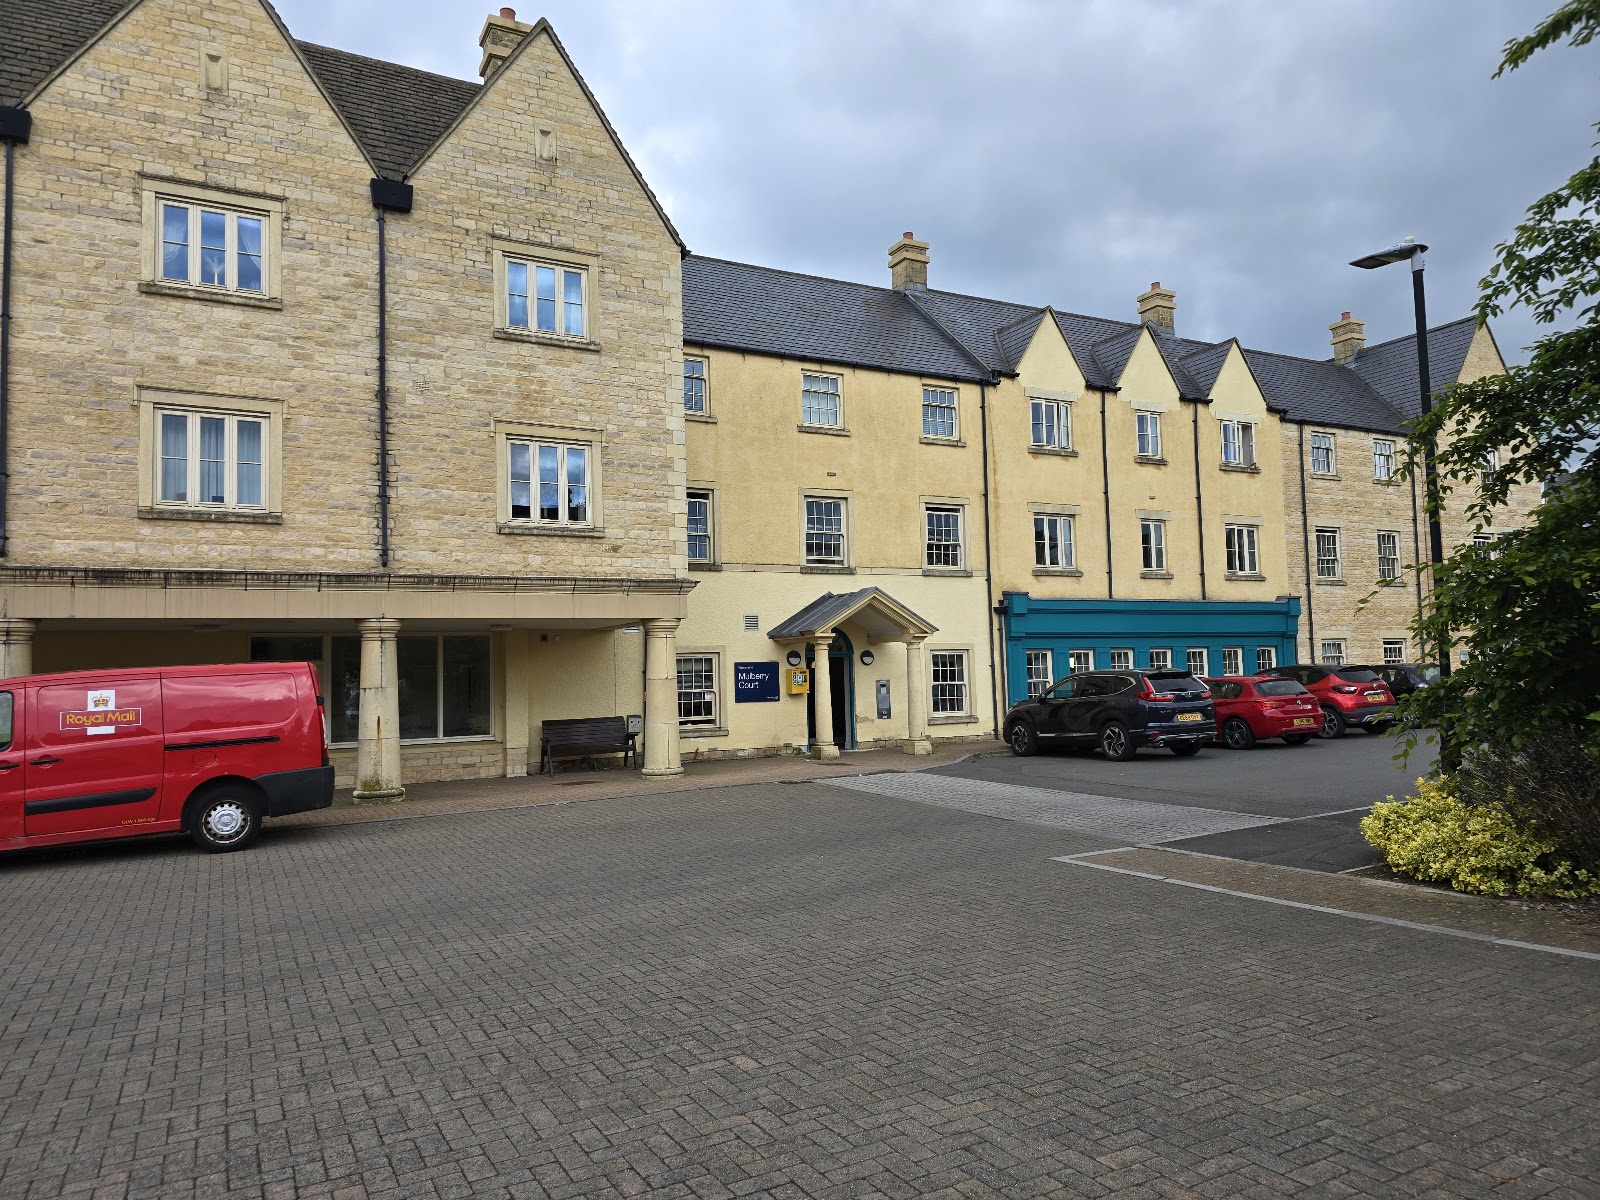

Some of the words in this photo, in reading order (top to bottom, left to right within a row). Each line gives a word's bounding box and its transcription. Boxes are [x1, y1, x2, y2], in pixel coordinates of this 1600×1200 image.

[738, 672, 770, 681] Mulberry
[738, 681, 759, 689] Court
[66, 712, 104, 726] Royal
[107, 710, 136, 723] Mail
